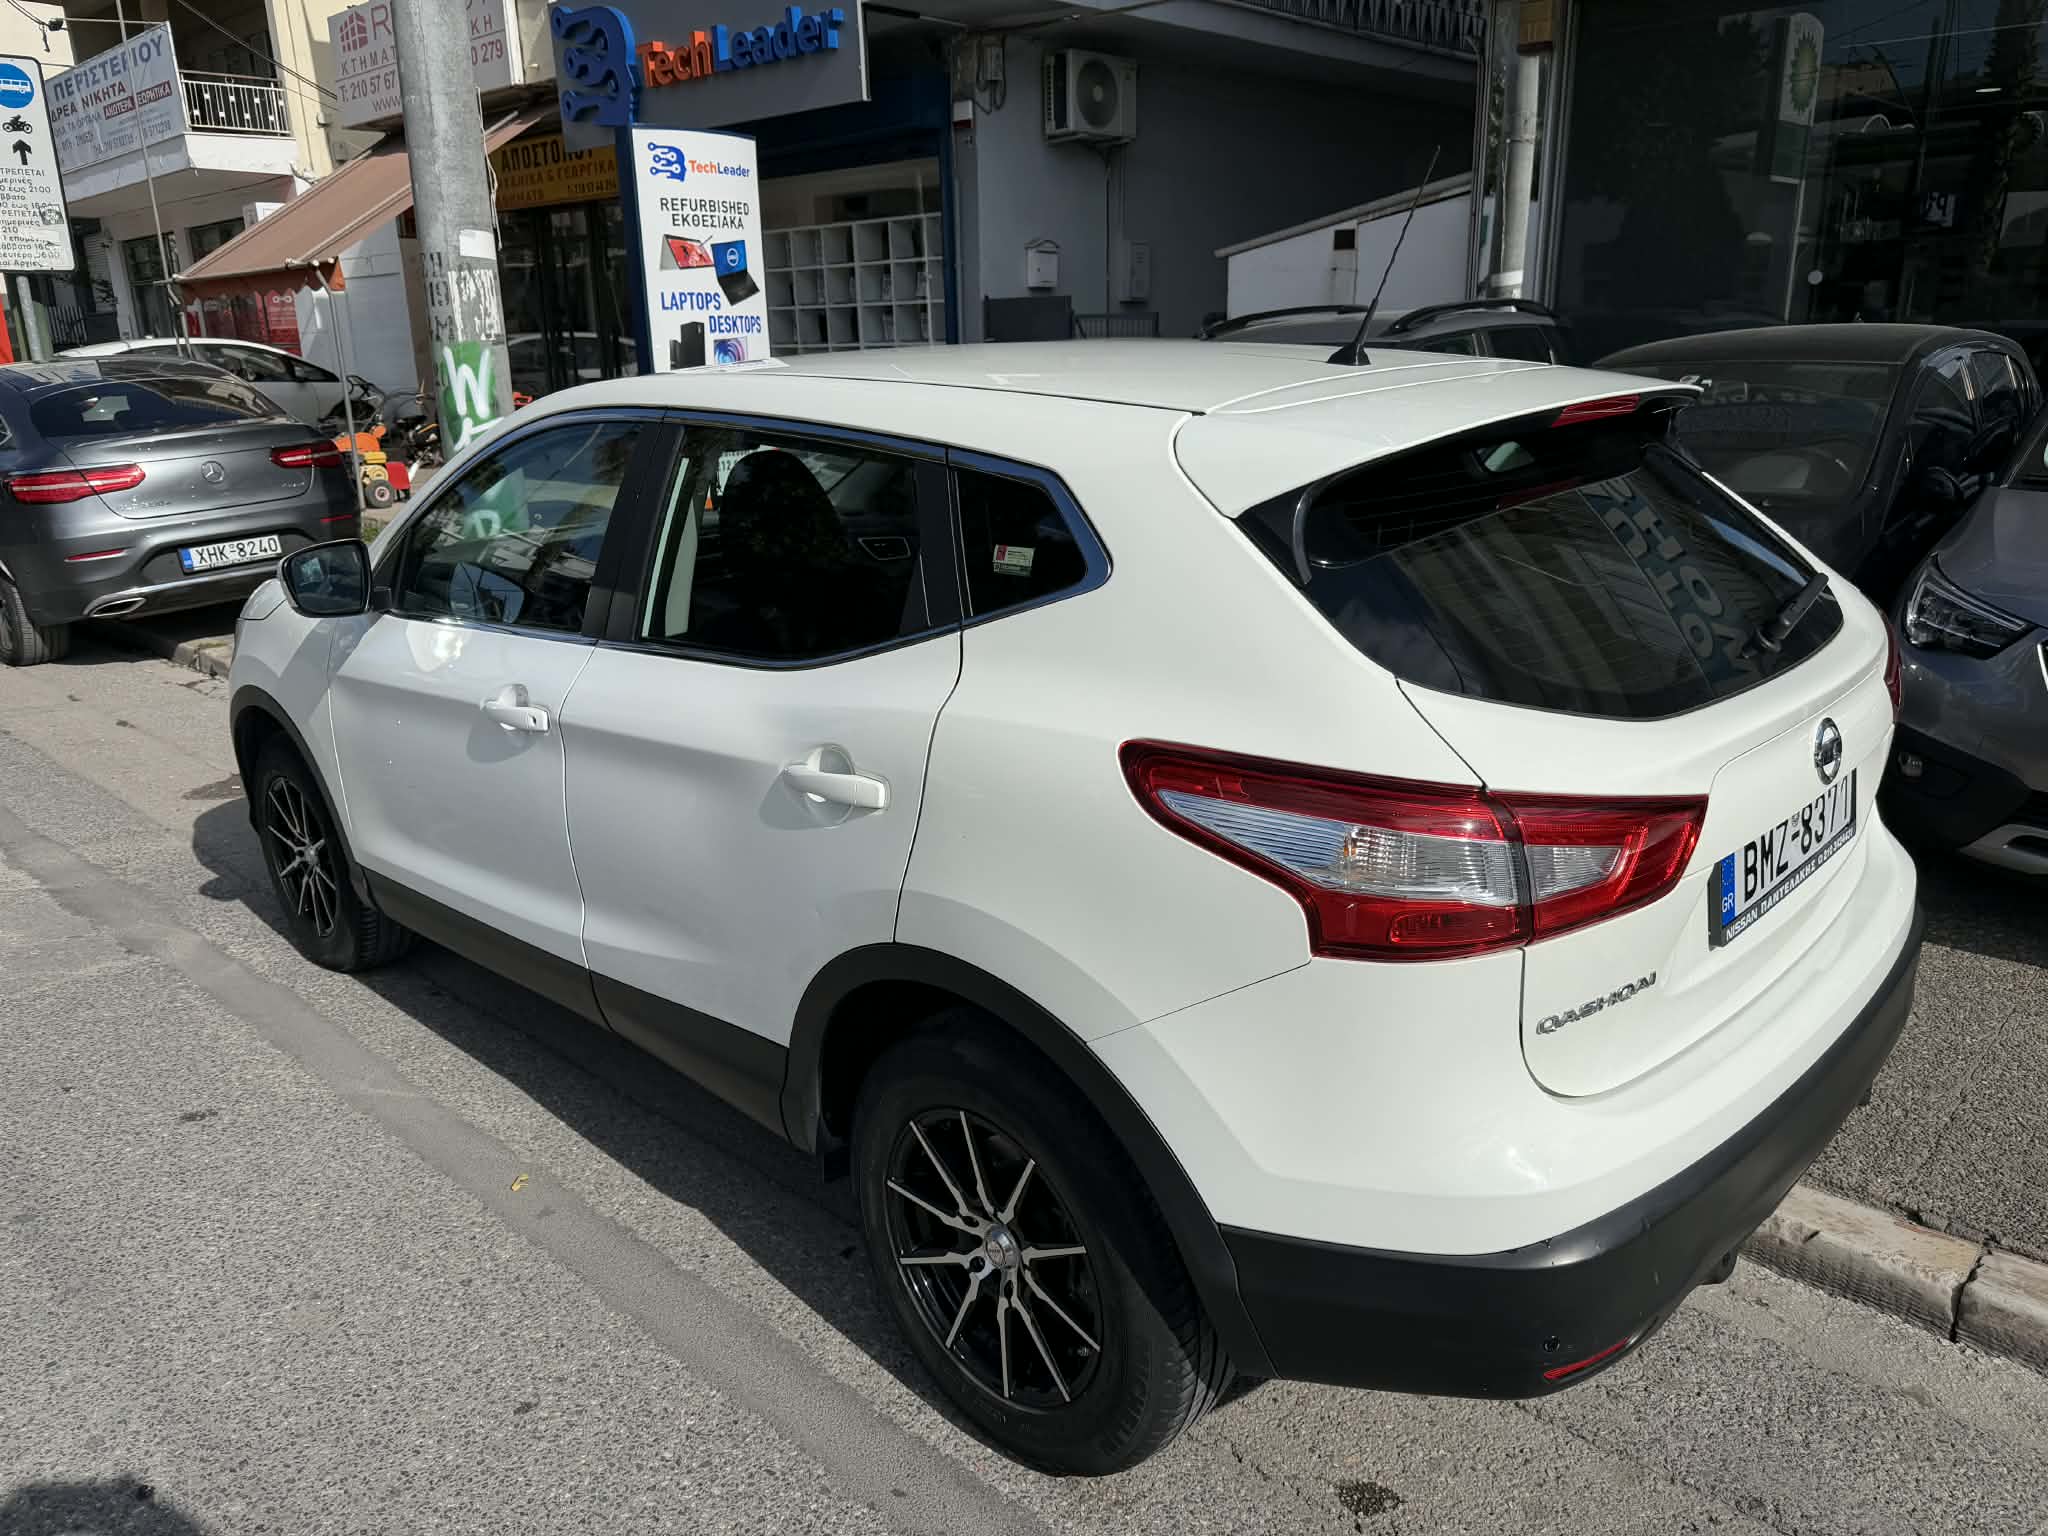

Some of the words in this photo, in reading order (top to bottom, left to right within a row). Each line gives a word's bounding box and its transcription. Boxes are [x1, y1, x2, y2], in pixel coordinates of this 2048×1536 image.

[636, 6, 846, 89] TechLeader
[350, 79, 368, 100] 210
[370, 74, 381, 96] 57
[480, 39, 504, 63] 279
[81, 81, 127, 109] ΝΙΚΗΤΑ
[138, 83, 172, 107] ΕΩΡΗΤΙΚΑ
[688, 159, 750, 178] TechLeader
[28, 185, 51, 193] 2100
[660, 197, 750, 216] REFURBISHED
[672, 213, 745, 230] ΕΚΘΕΣΙΑΚΑ
[660, 291, 722, 311] LAPTOPS
[709, 314, 762, 334] DESKTOPS
[195, 537, 278, 565] XHK-8240
[1743, 774, 1849, 902] BMZ-8371
[1721, 892, 1734, 913] GR
[1726, 907, 1758, 941] NISSAN
[1761, 859, 1816, 916] ΠΑΝΤΕΛΑΚΗΣ
[1536, 969, 1657, 1035] QASHQAI
